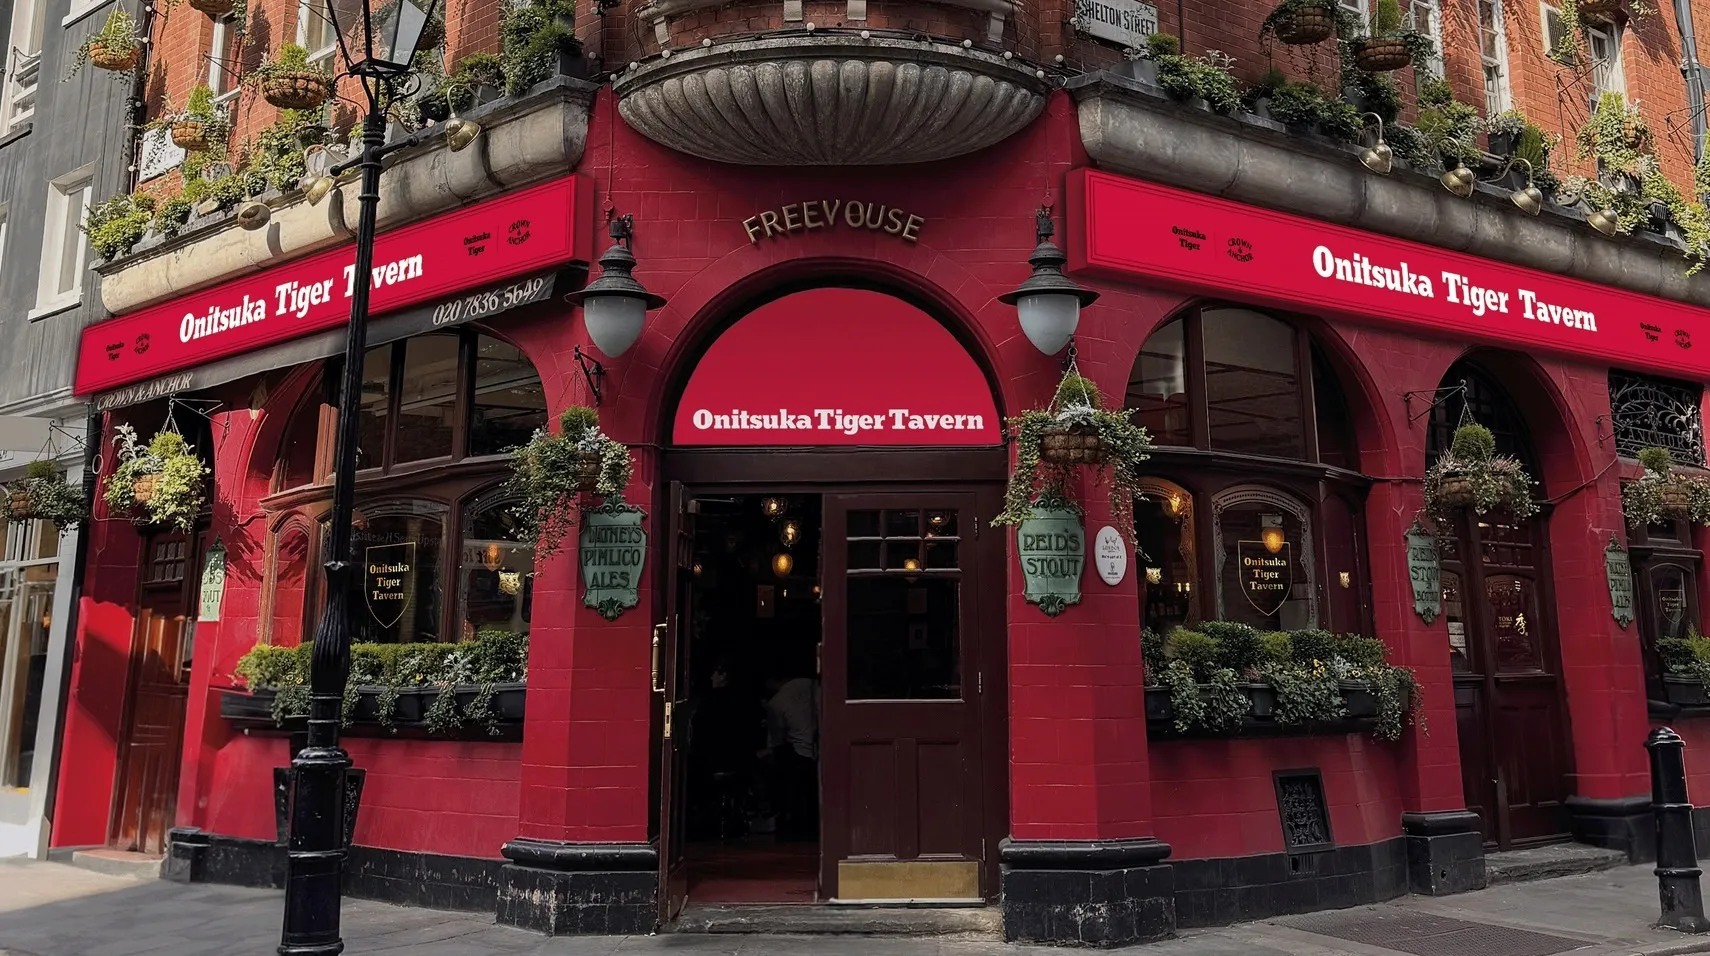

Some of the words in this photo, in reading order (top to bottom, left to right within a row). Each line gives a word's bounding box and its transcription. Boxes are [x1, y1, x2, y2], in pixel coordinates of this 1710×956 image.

[1124, 10, 1156, 36] STREET
[1172, 226, 1206, 240] Onitsuka
[468, 245, 485, 256] Tiger
[1179, 238, 1200, 251] Tiger
[1312, 245, 1434, 298] Onitsuka
[1441, 271, 1509, 317] Tiger
[1518, 288, 1597, 332] Tavern
[179, 294, 266, 343] Onitsuka
[275, 278, 334, 318] Tiger
[343, 253, 423, 298] Tvern
[433, 300, 461, 325] 020
[463, 289, 499, 319] 7836
[503, 278, 543, 307] 5649
[97, 387, 134, 411] CROWN
[135, 386, 146, 403] &
[145, 372, 194, 399] ANCHOR
[692, 409, 812, 430] Onitsuka
[814, 409, 885, 435] Tiger
[889, 409, 984, 430] Tavern
[1023, 528, 1080, 552] REID'S
[584, 548, 641, 567] PIMLICO
[1244, 557, 1287, 566] Onitsuka
[369, 563, 410, 574] Onitsuka
[1026, 557, 1080, 577] STOUT
[1252, 569, 1279, 580] Tiger
[376, 577, 401, 589] Tiger
[590, 571, 631, 589] ALES
[1249, 581, 1284, 590] Tavern
[372, 590, 404, 600] Tavern
